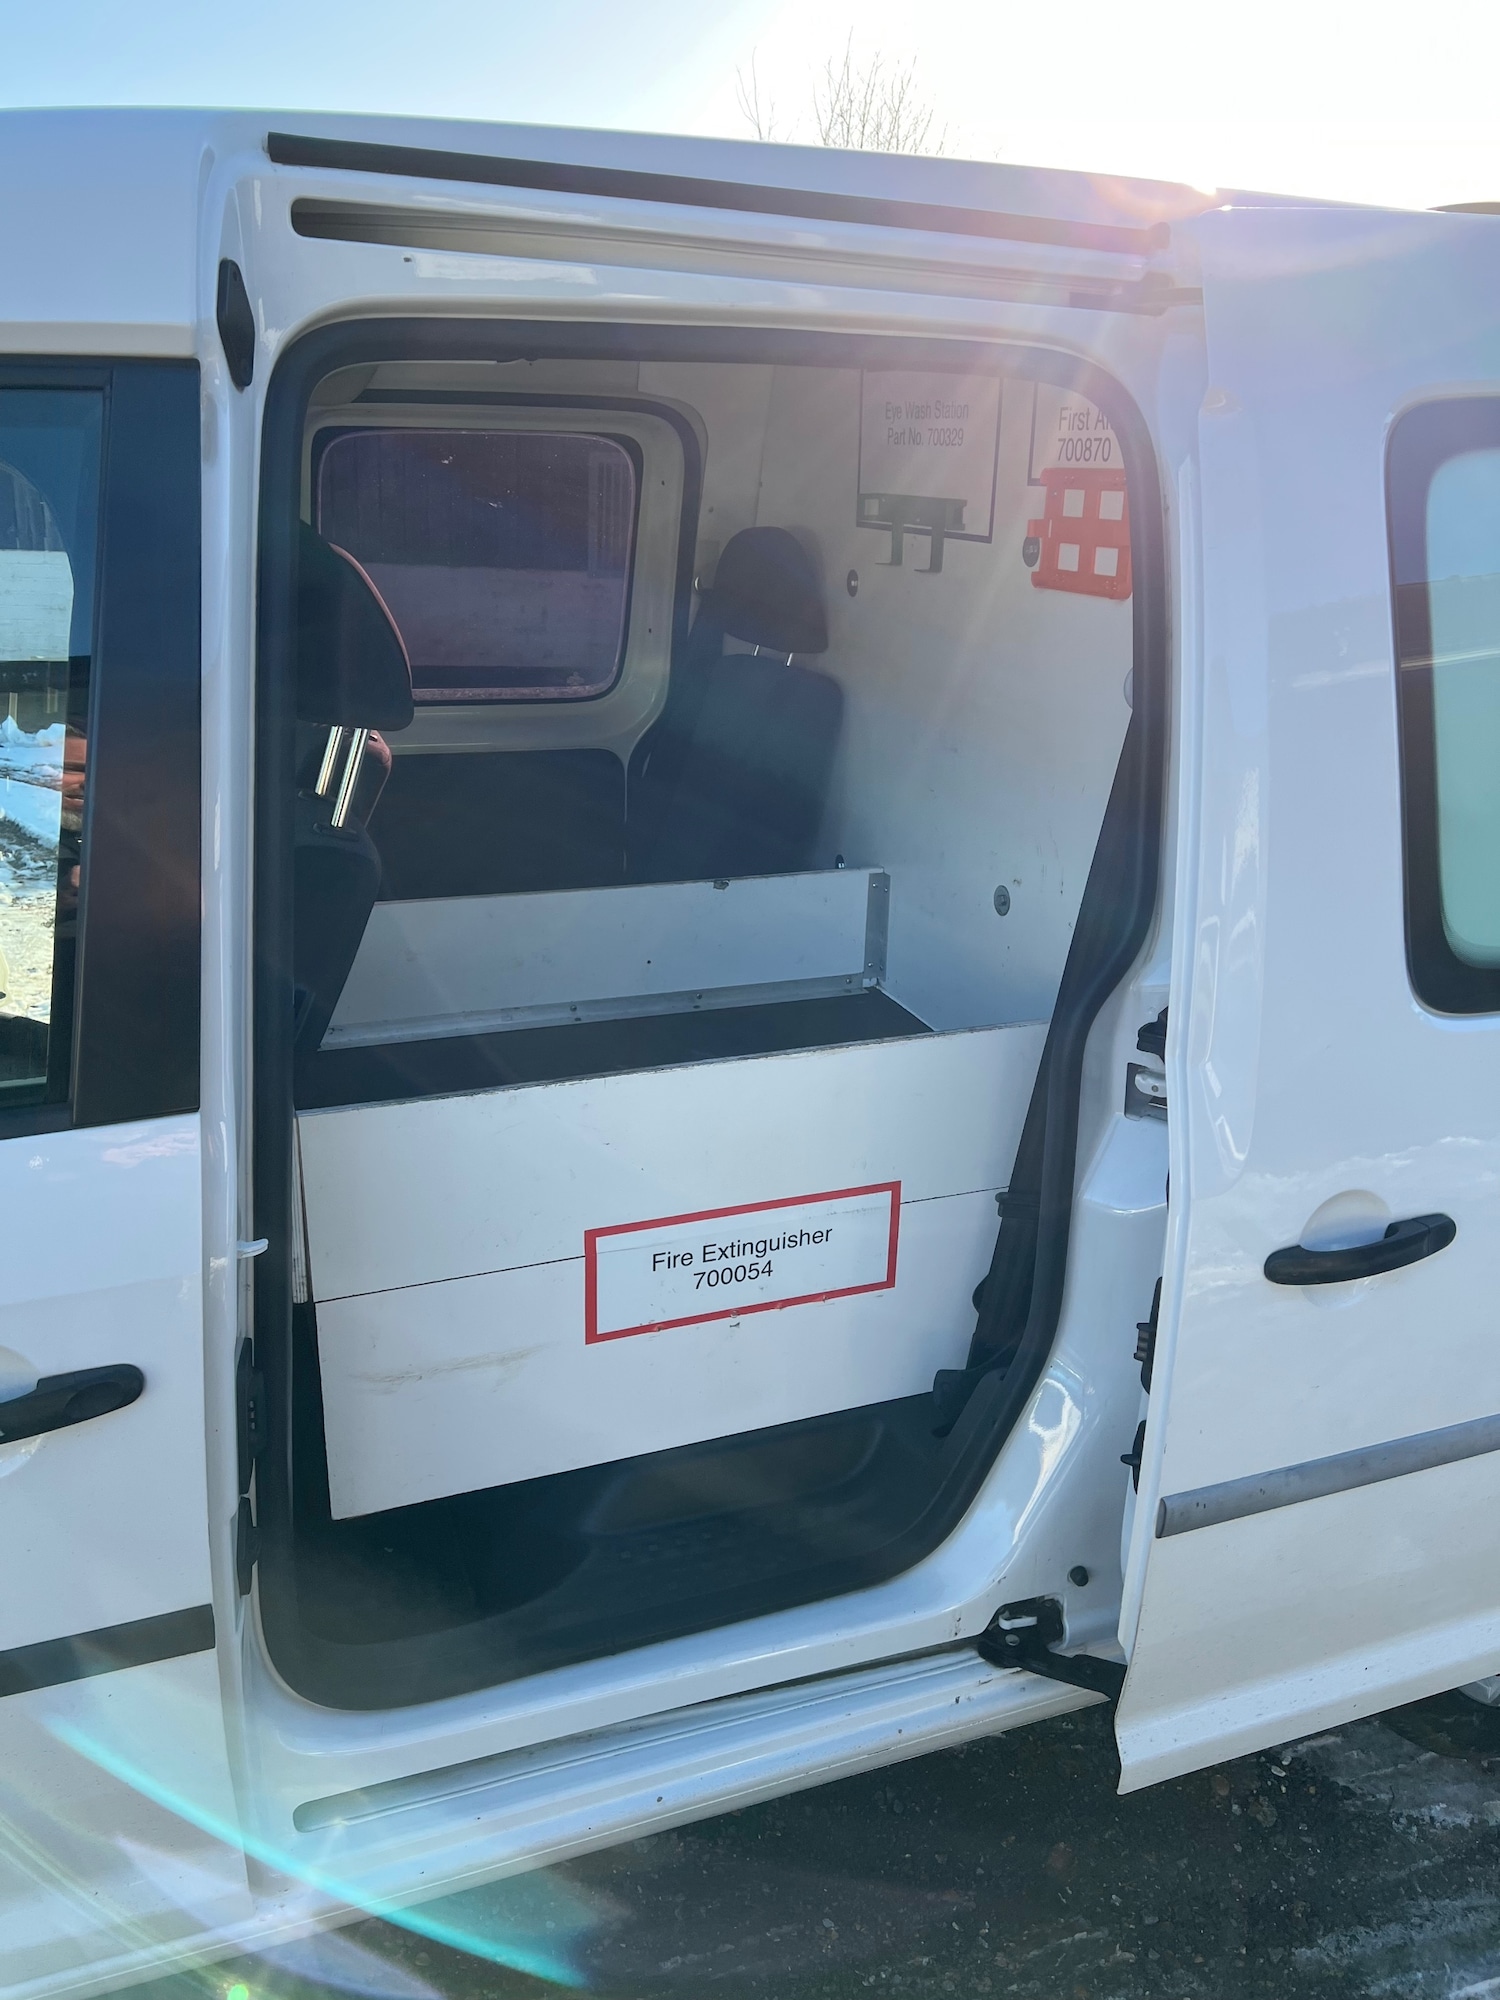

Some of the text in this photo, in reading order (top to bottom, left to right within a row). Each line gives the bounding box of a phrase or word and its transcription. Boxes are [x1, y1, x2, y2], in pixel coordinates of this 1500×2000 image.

[885, 400, 969, 424] Eye Wash Station
[1058, 406, 1109, 431] First Ai
[887, 426, 964, 447] Part No. 700329
[1057, 437, 1111, 462] 700870
[652, 1228, 833, 1272] Fire Extinguisher
[693, 1259, 774, 1290] 700054
